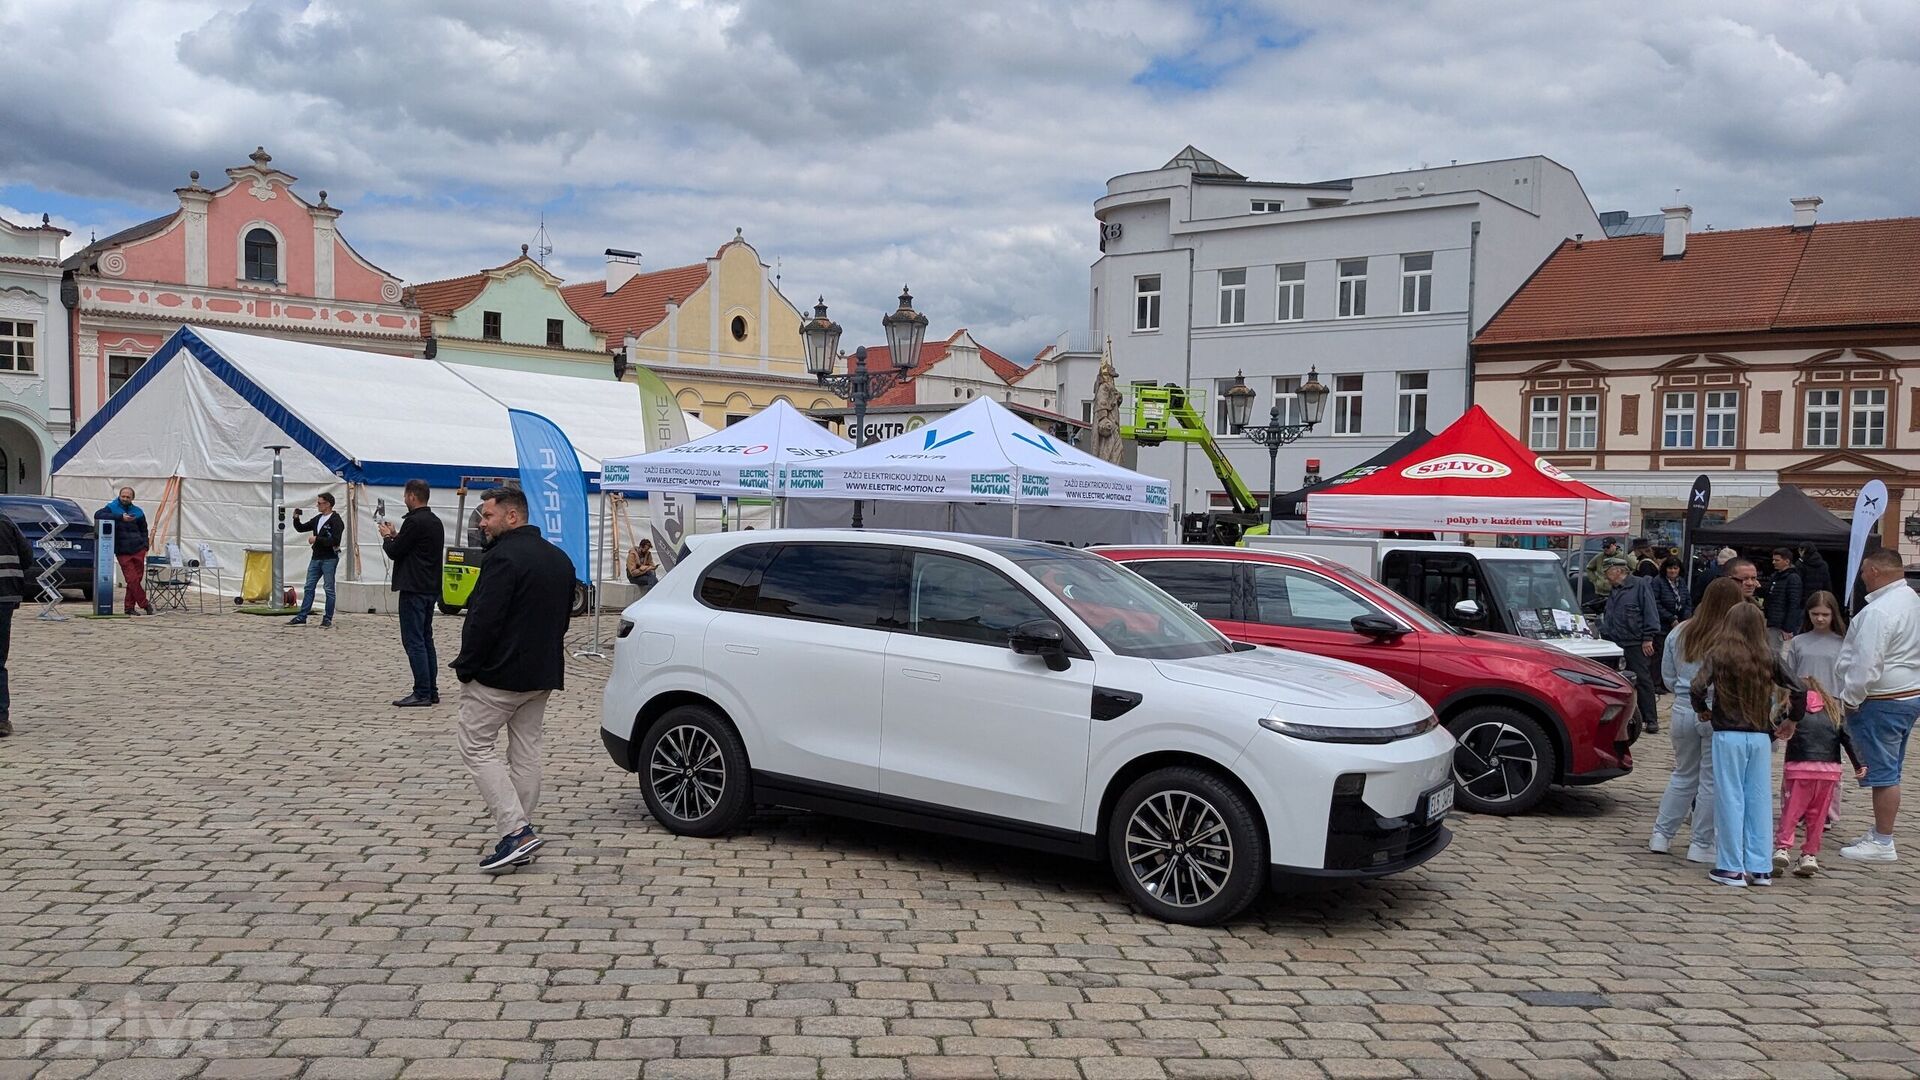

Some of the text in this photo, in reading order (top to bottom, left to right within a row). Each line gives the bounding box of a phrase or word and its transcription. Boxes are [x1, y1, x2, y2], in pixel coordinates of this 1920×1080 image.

[656, 395, 672, 449] -BIKE
[604, 465, 630, 473] ELECTRIC
[1417, 461, 1494, 474] SELVO
[739, 469, 769, 478] ELECTRIC
[791, 469, 824, 478] ELECTRIC
[863, 472, 912, 481] ELEKTRICKOU
[970, 474, 1010, 483] ELECTRIC
[739, 479, 769, 488] MOTION
[790, 479, 824, 489] MOTION
[1022, 474, 1049, 485] ELECTRIC
[970, 484, 1010, 495] MOTION
[1022, 485, 1049, 496] MOTION
[1146, 485, 1167, 495] ELECTRIC
[1446, 516, 1478, 525] pohyb
[1491, 516, 1532, 526] každém
